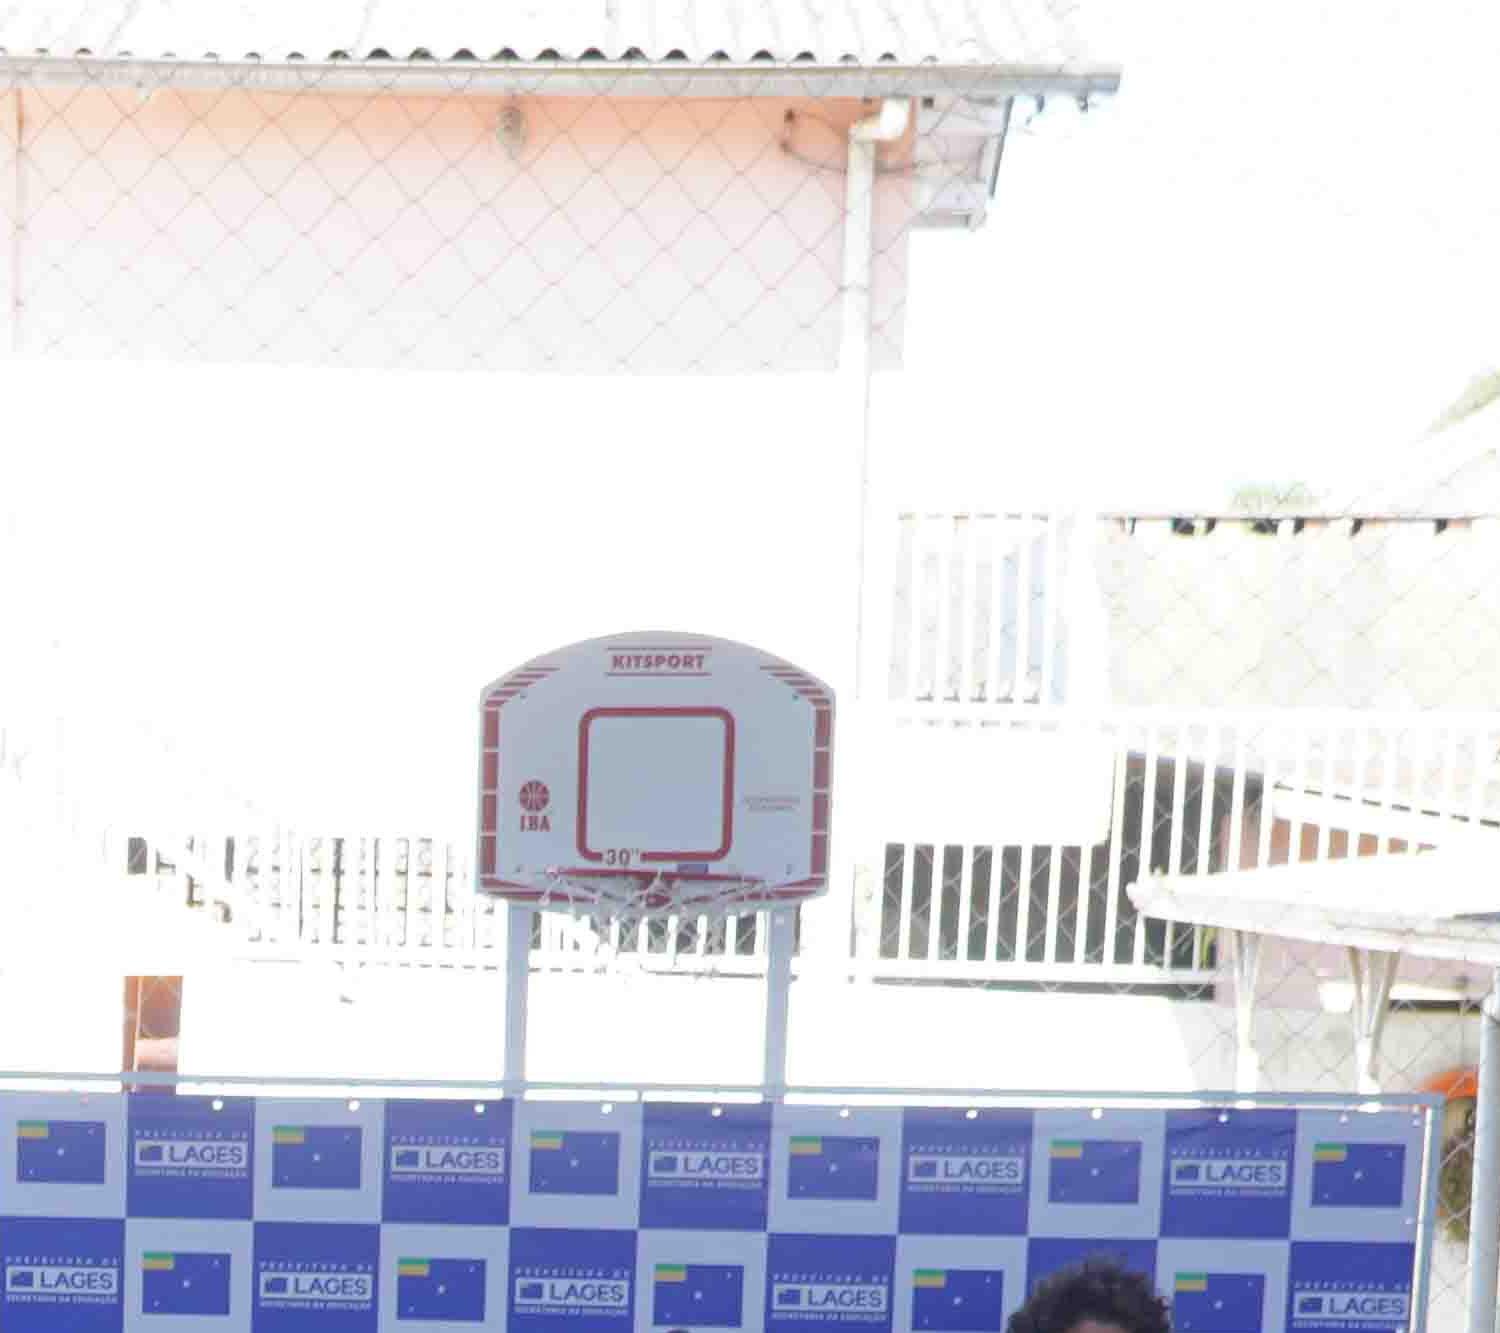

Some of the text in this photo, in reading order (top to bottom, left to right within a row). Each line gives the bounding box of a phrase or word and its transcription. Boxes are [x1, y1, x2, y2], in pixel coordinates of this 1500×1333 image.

[169, 1145, 243, 1165] LAGES
[424, 1151, 499, 1169] LAGES
[684, 1156, 760, 1175] LAGES
[943, 1160, 1019, 1179] LAGES
[1206, 1164, 1282, 1183] LAGES
[41, 1270, 113, 1289] LAGES
[295, 1277, 367, 1296] LAGES
[549, 1283, 625, 1302] LAGES
[808, 1289, 882, 1307] LAGES
[1330, 1297, 1404, 1315] LAGES
